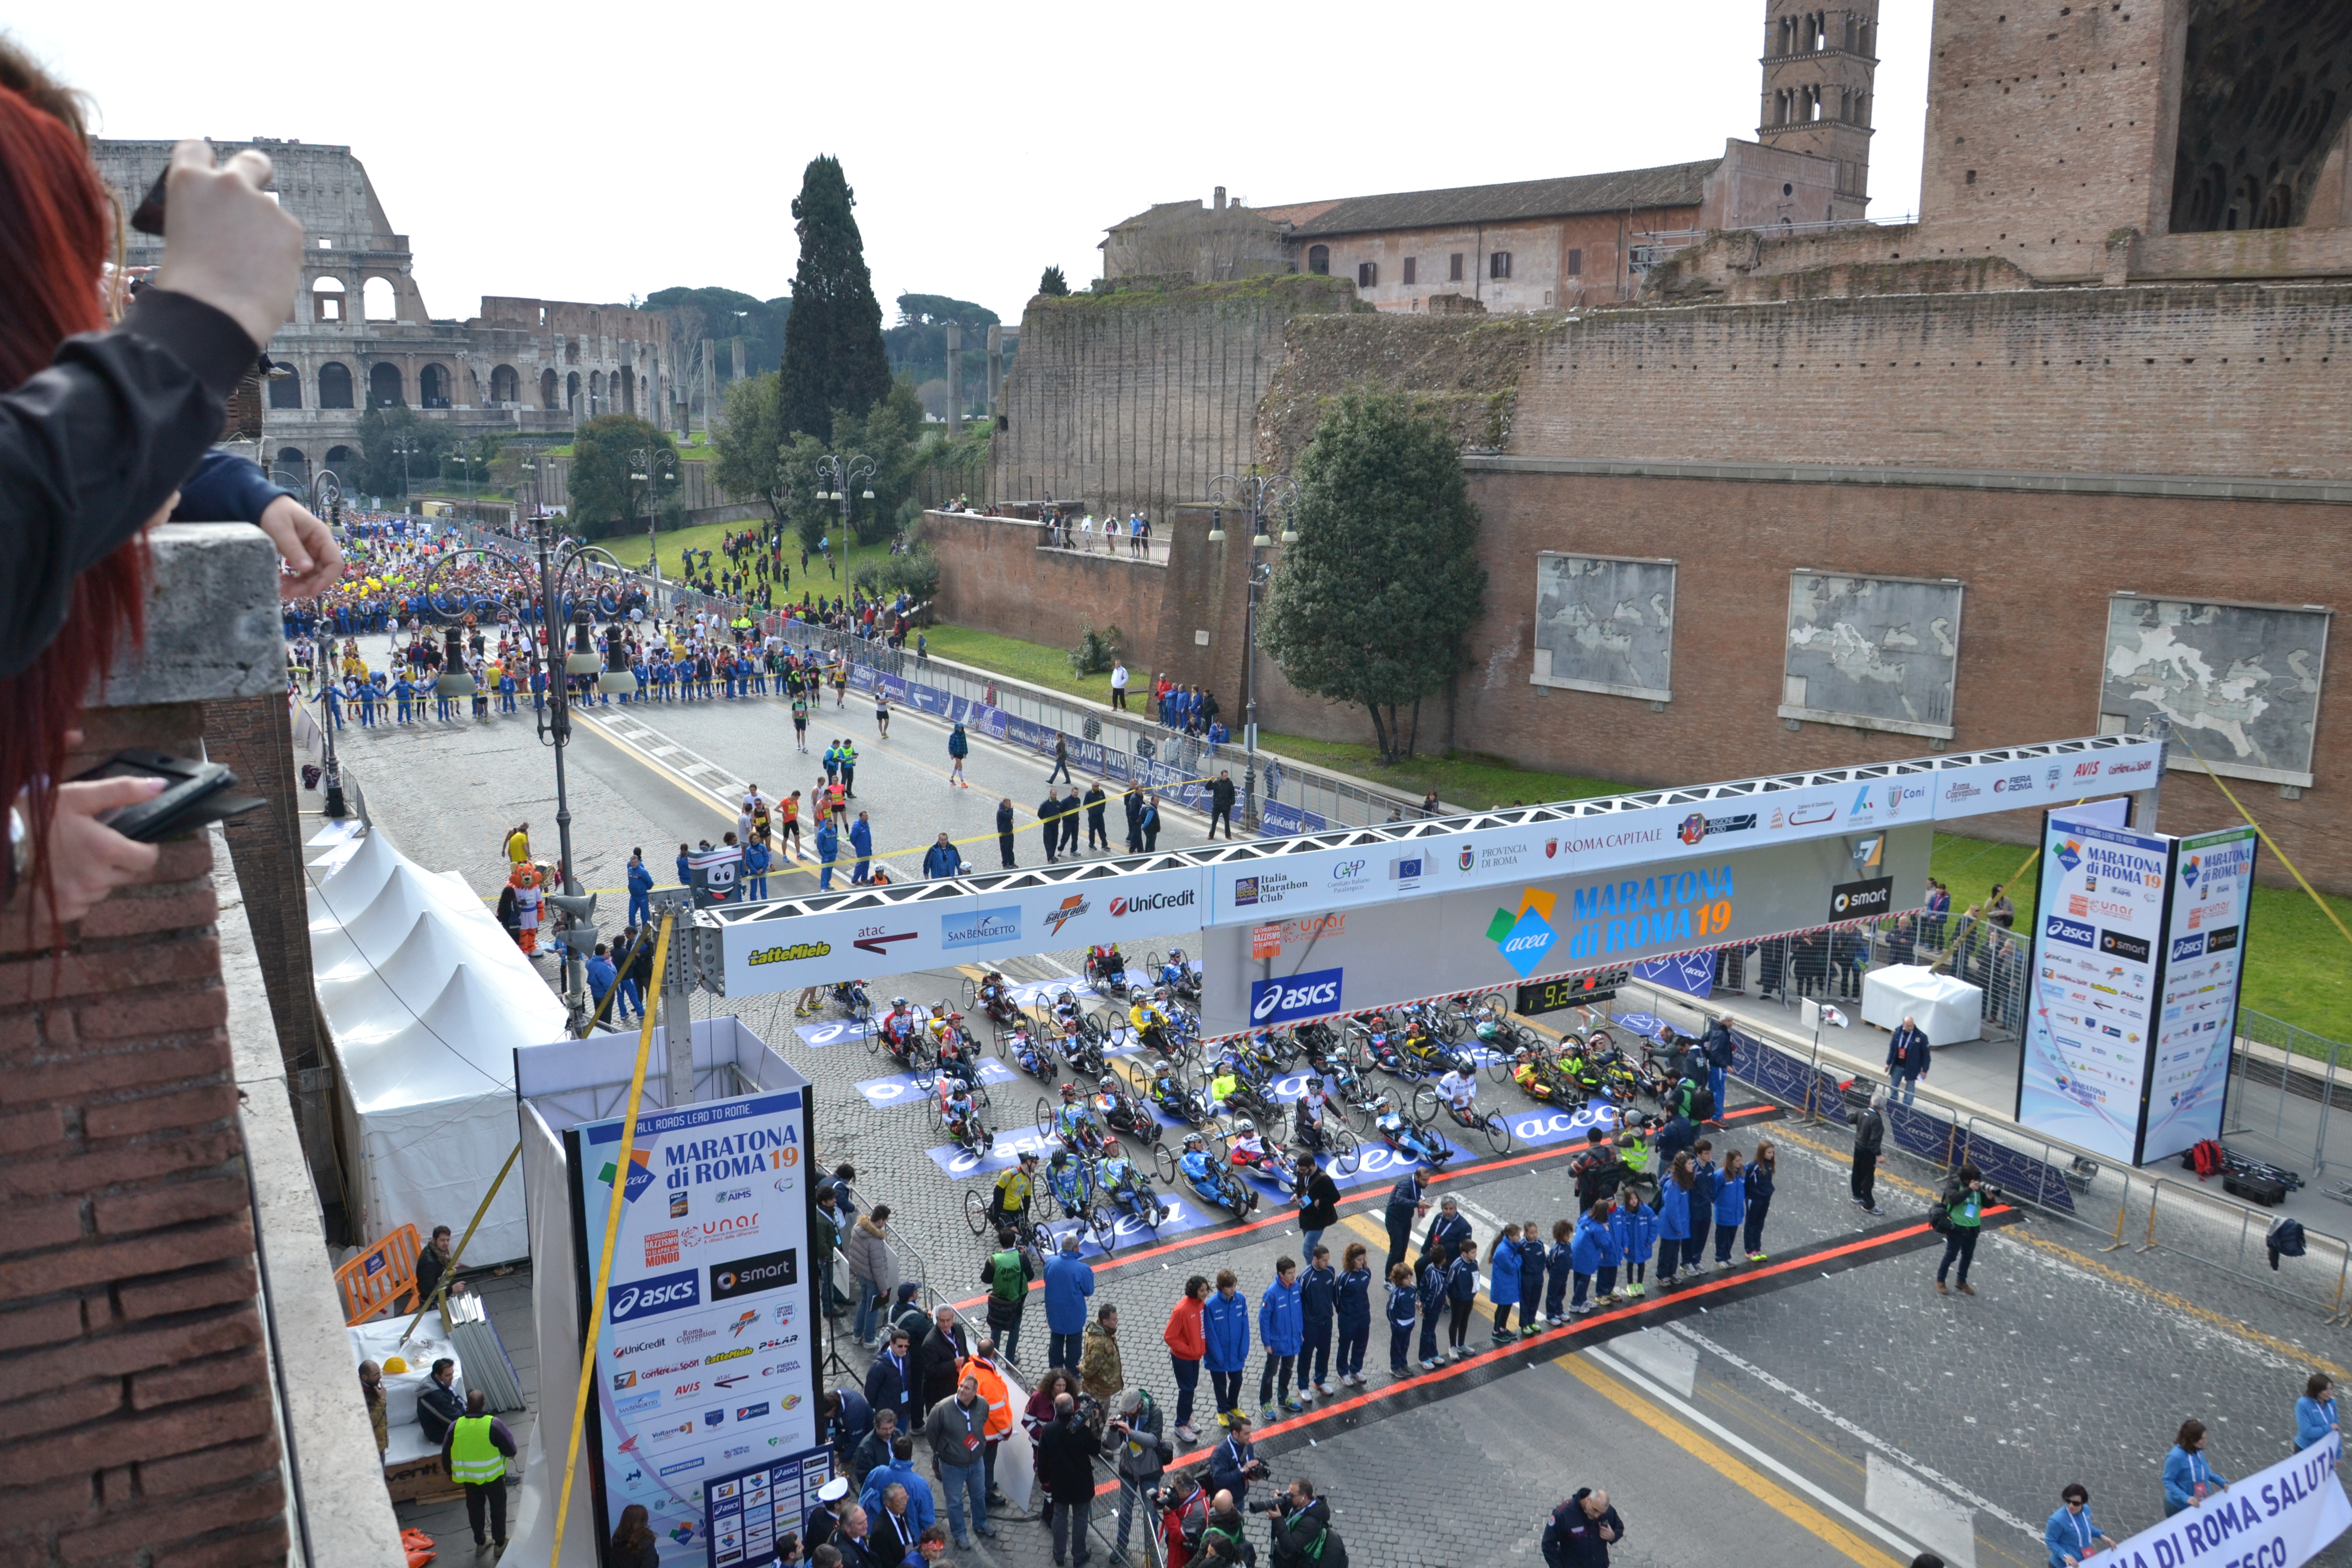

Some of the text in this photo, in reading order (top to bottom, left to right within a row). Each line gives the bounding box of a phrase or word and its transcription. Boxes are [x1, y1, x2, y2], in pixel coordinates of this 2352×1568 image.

[885, 684, 904, 697] HONDA
[1081, 743, 1102, 762] AVIS
[1106, 747, 1126, 769] AVIS
[2073, 761, 2100, 777] AVIS
[1952, 782, 1970, 791] Roma
[2008, 782, 2032, 792] ROMA
[2009, 775, 2031, 784] FIERA
[1903, 787, 1925, 799] Coni
[1946, 787, 1980, 799] Convention
[1270, 815, 1295, 830] UniCredit
[1709, 817, 1734, 826] REGIONE
[1709, 825, 1726, 834] LAZIO
[1564, 828, 1662, 854] ROMA CAPITALE
[1482, 844, 1527, 857] PROVINCIA
[2204, 848, 2250, 868] MARATONA
[1481, 855, 1517, 868] DI ROMA
[2087, 846, 2162, 875] MARATONA
[1261, 873, 1287, 884] Italia
[2087, 862, 2161, 889] di ROMA 19
[2202, 869, 2211, 882] di
[2212, 864, 2237, 881] ROMA
[2238, 862, 2249, 875] 19
[1261, 880, 1308, 893] Marathon
[1328, 877, 1370, 889] Comitato Italiano
[1334, 884, 1364, 894] Paralimpico
[1573, 865, 1734, 922] MARATONA
[1850, 888, 1886, 906] smart
[1129, 890, 1194, 913] UniCredit
[2101, 901, 2133, 915] unar
[1044, 901, 1090, 925] Gatorade
[1301, 914, 1346, 932] unar
[1570, 901, 1732, 959] di ROMA 19
[858, 926, 886, 937] atac
[948, 925, 1015, 941] SAN BENEDETTO
[1254, 931, 1281, 942] RAZZISMO
[2062, 926, 2092, 942] asics
[2218, 933, 2236, 943] smart
[1505, 932, 1550, 952] acea
[2117, 940, 2146, 955] smart
[2183, 940, 2202, 954] asics
[749, 942, 830, 965] LatteMiele
[1253, 946, 1281, 960] MONDO
[1684, 967, 1706, 978] acea
[1571, 971, 1628, 992] POLAR
[1281, 982, 1337, 1010] asics
[2071, 1080, 2106, 1097] MARATONA
[2077, 1089, 2097, 1100] ROMA
[2097, 1095, 2106, 1103] 19
[637, 1121, 653, 1134] ALL
[656, 1115, 685, 1130] ROADS
[688, 1111, 709, 1124] LEAD
[712, 1109, 723, 1120] TO
[666, 1124, 798, 1167] MARATONA
[667, 1146, 799, 1189] di ROMA 19
[728, 1190, 751, 1202] AIMS
[703, 1213, 758, 1234] unar
[645, 1236, 678, 1250] RAZZISMO
[657, 1246, 670, 1254] APRE
[646, 1252, 680, 1268] MONDO
[740, 1261, 790, 1283] smart
[640, 1280, 694, 1308] asics
[676, 1328, 717, 1343] Convention
[682, 1328, 703, 1336] Roma
[625, 1338, 666, 1355] UniCredit
[758, 1334, 798, 1350] POLAR
[704, 1346, 754, 1365] LatteMiele
[641, 1359, 699, 1380] Corriere Sport
[777, 1360, 798, 1369] FIERA
[777, 1364, 801, 1375] ROMA
[716, 1373, 731, 1381] atac
[675, 1381, 700, 1396] AVIS
[629, 1400, 657, 1412] BENEDETTO
[750, 1405, 767, 1415] pepsi
[652, 1427, 679, 1438] Voltaren
[618, 1447, 640, 1455] HONDA
[782, 1465, 798, 1475] asics
[2152, 1447, 2336, 1568] DI ROMA SALUTA
